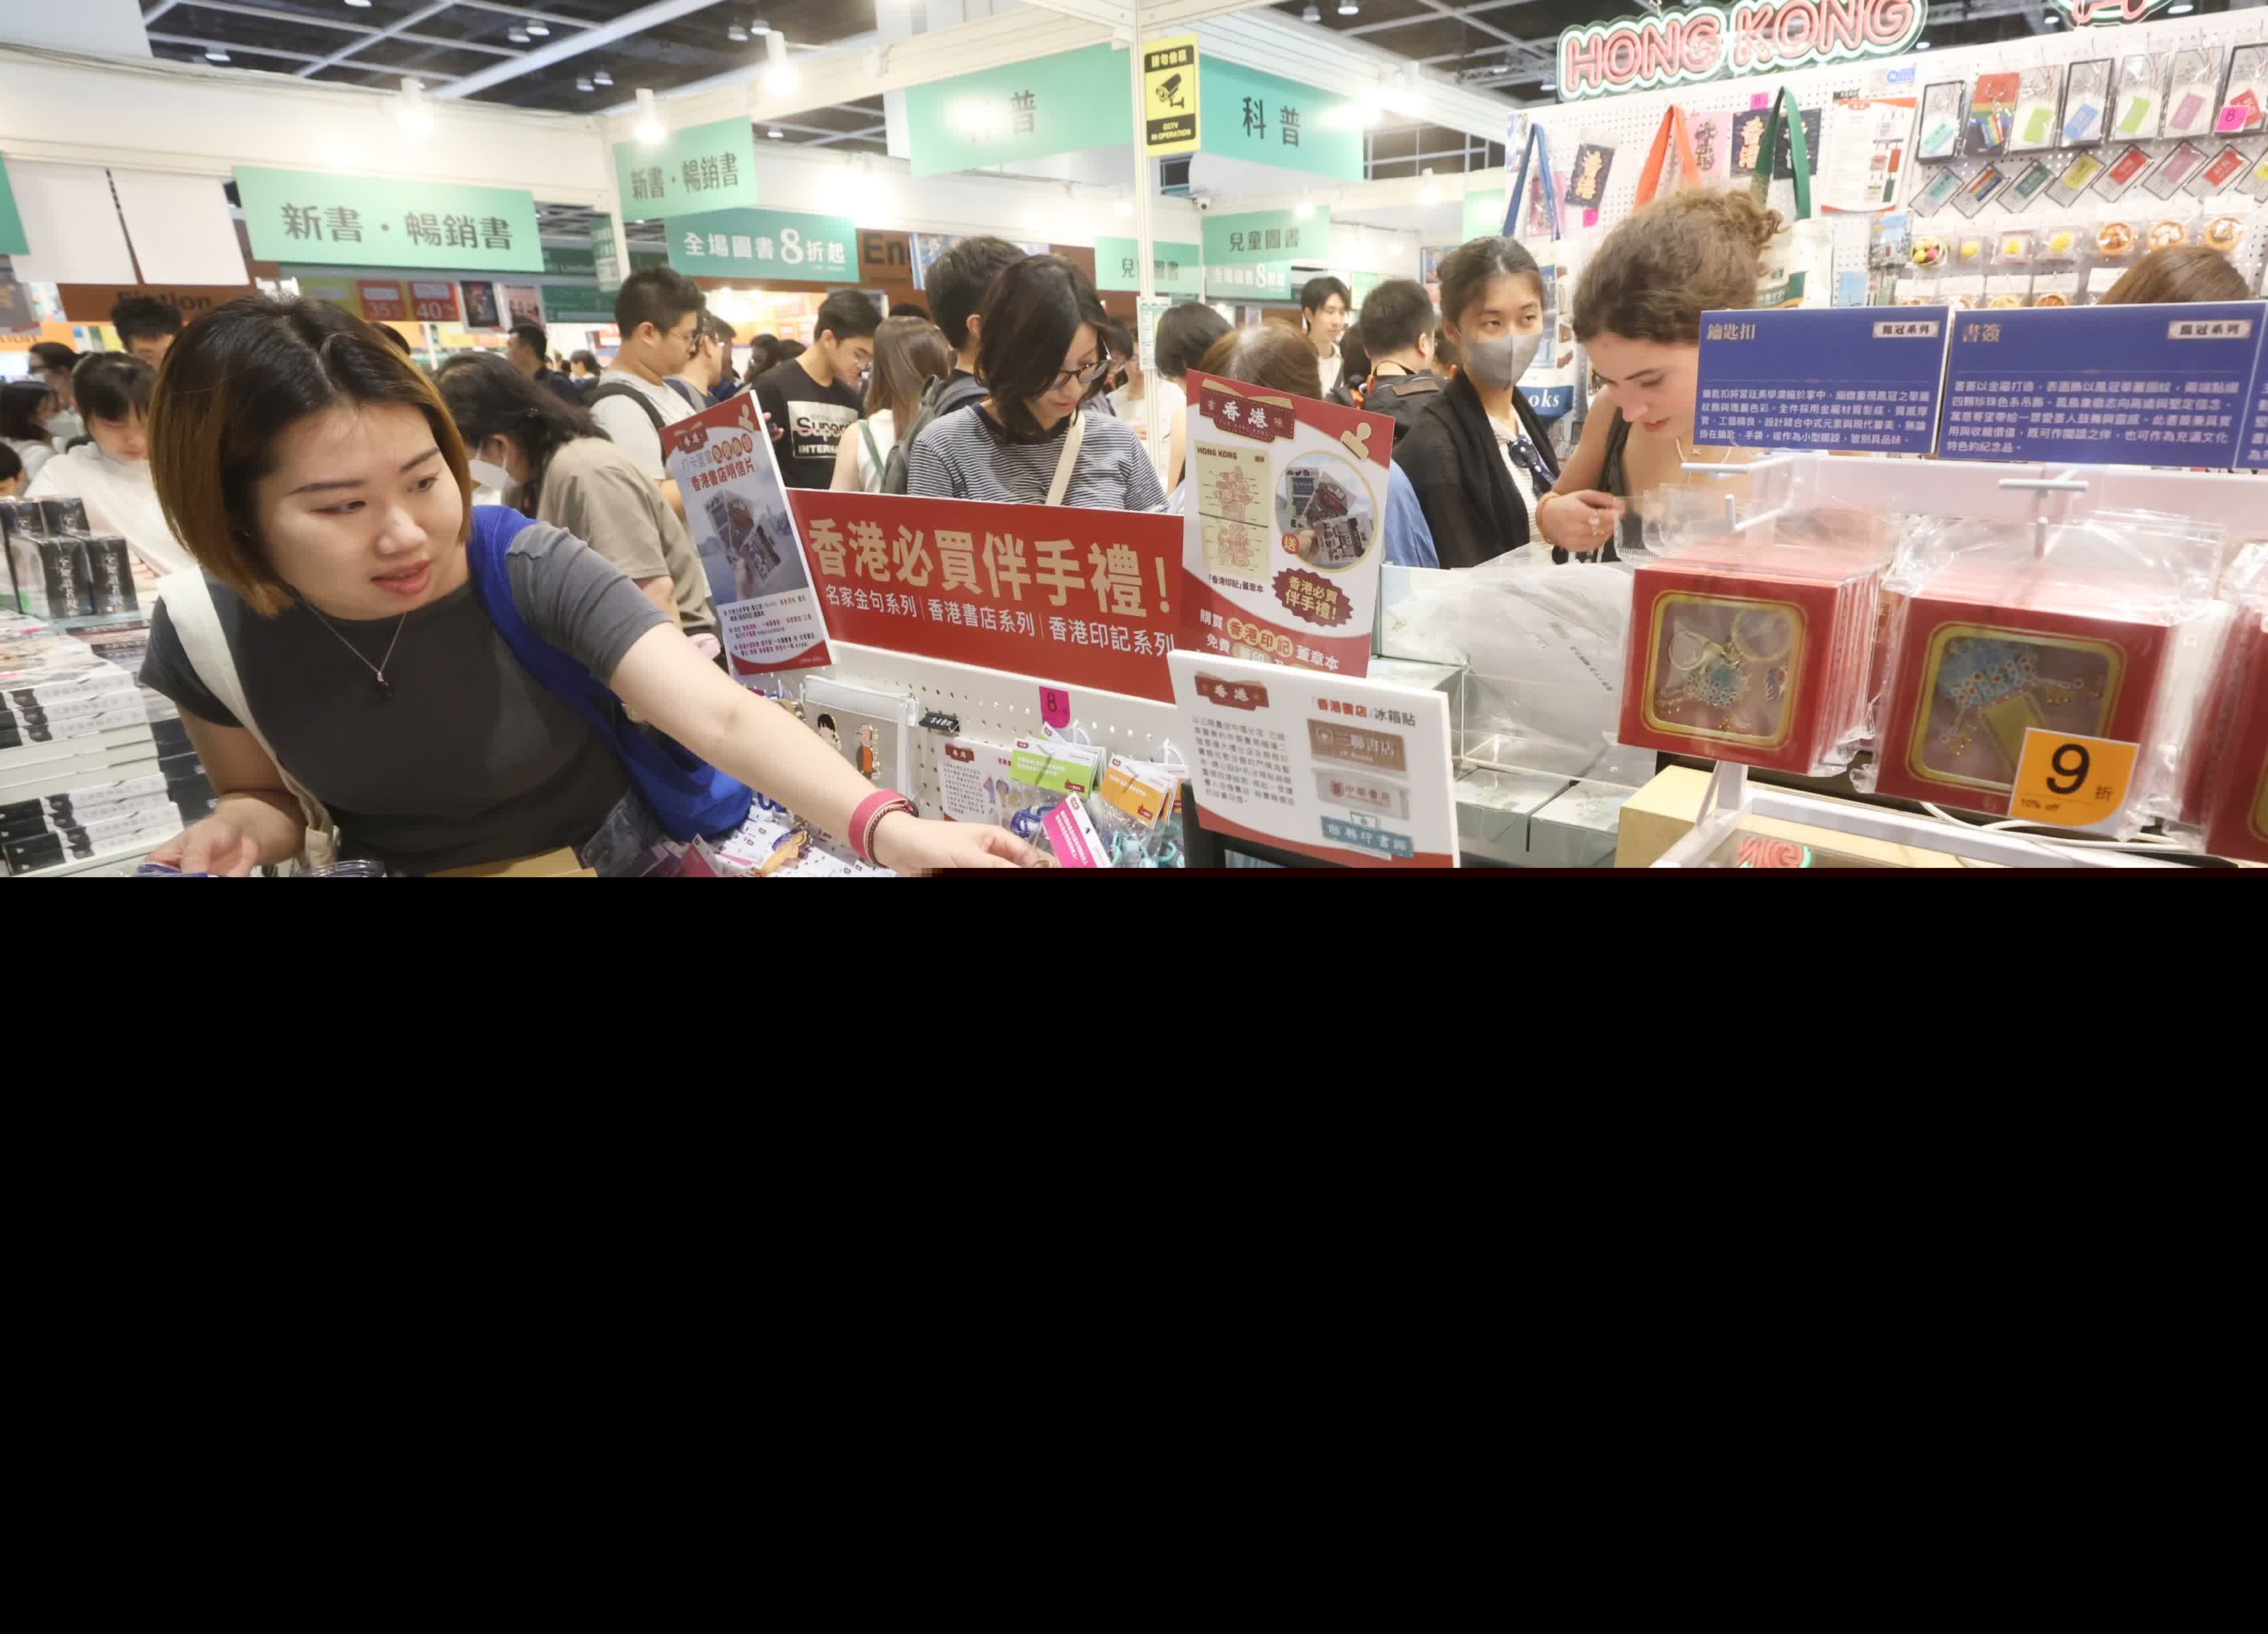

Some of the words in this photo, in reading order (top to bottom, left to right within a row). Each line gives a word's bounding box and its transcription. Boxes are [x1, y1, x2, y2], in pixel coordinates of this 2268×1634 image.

[1566, 13, 1724, 92] HONG
[1734, 0, 1915, 64] KONG
[1162, 121, 1179, 131] CCTV
[1242, 96, 1300, 148] 科普
[2225, 108, 2236, 122] 8
[863, 234, 911, 266] En
[1122, 257, 1179, 281] 兒圖書
[797, 417, 849, 442] Super
[1197, 447, 1217, 457] HONG
[1219, 449, 1237, 459] KONG
[1288, 575, 1338, 605] 香港必買
[825, 584, 917, 617] 名家金句系列
[927, 598, 1035, 637] 香港書店系列
[1049, 615, 1175, 658] 香港印記系列
[1047, 692, 1057, 713] 8
[2046, 743, 2090, 795] 9
[2095, 785, 2113, 803] 折
[2020, 798, 2042, 810] 10%
